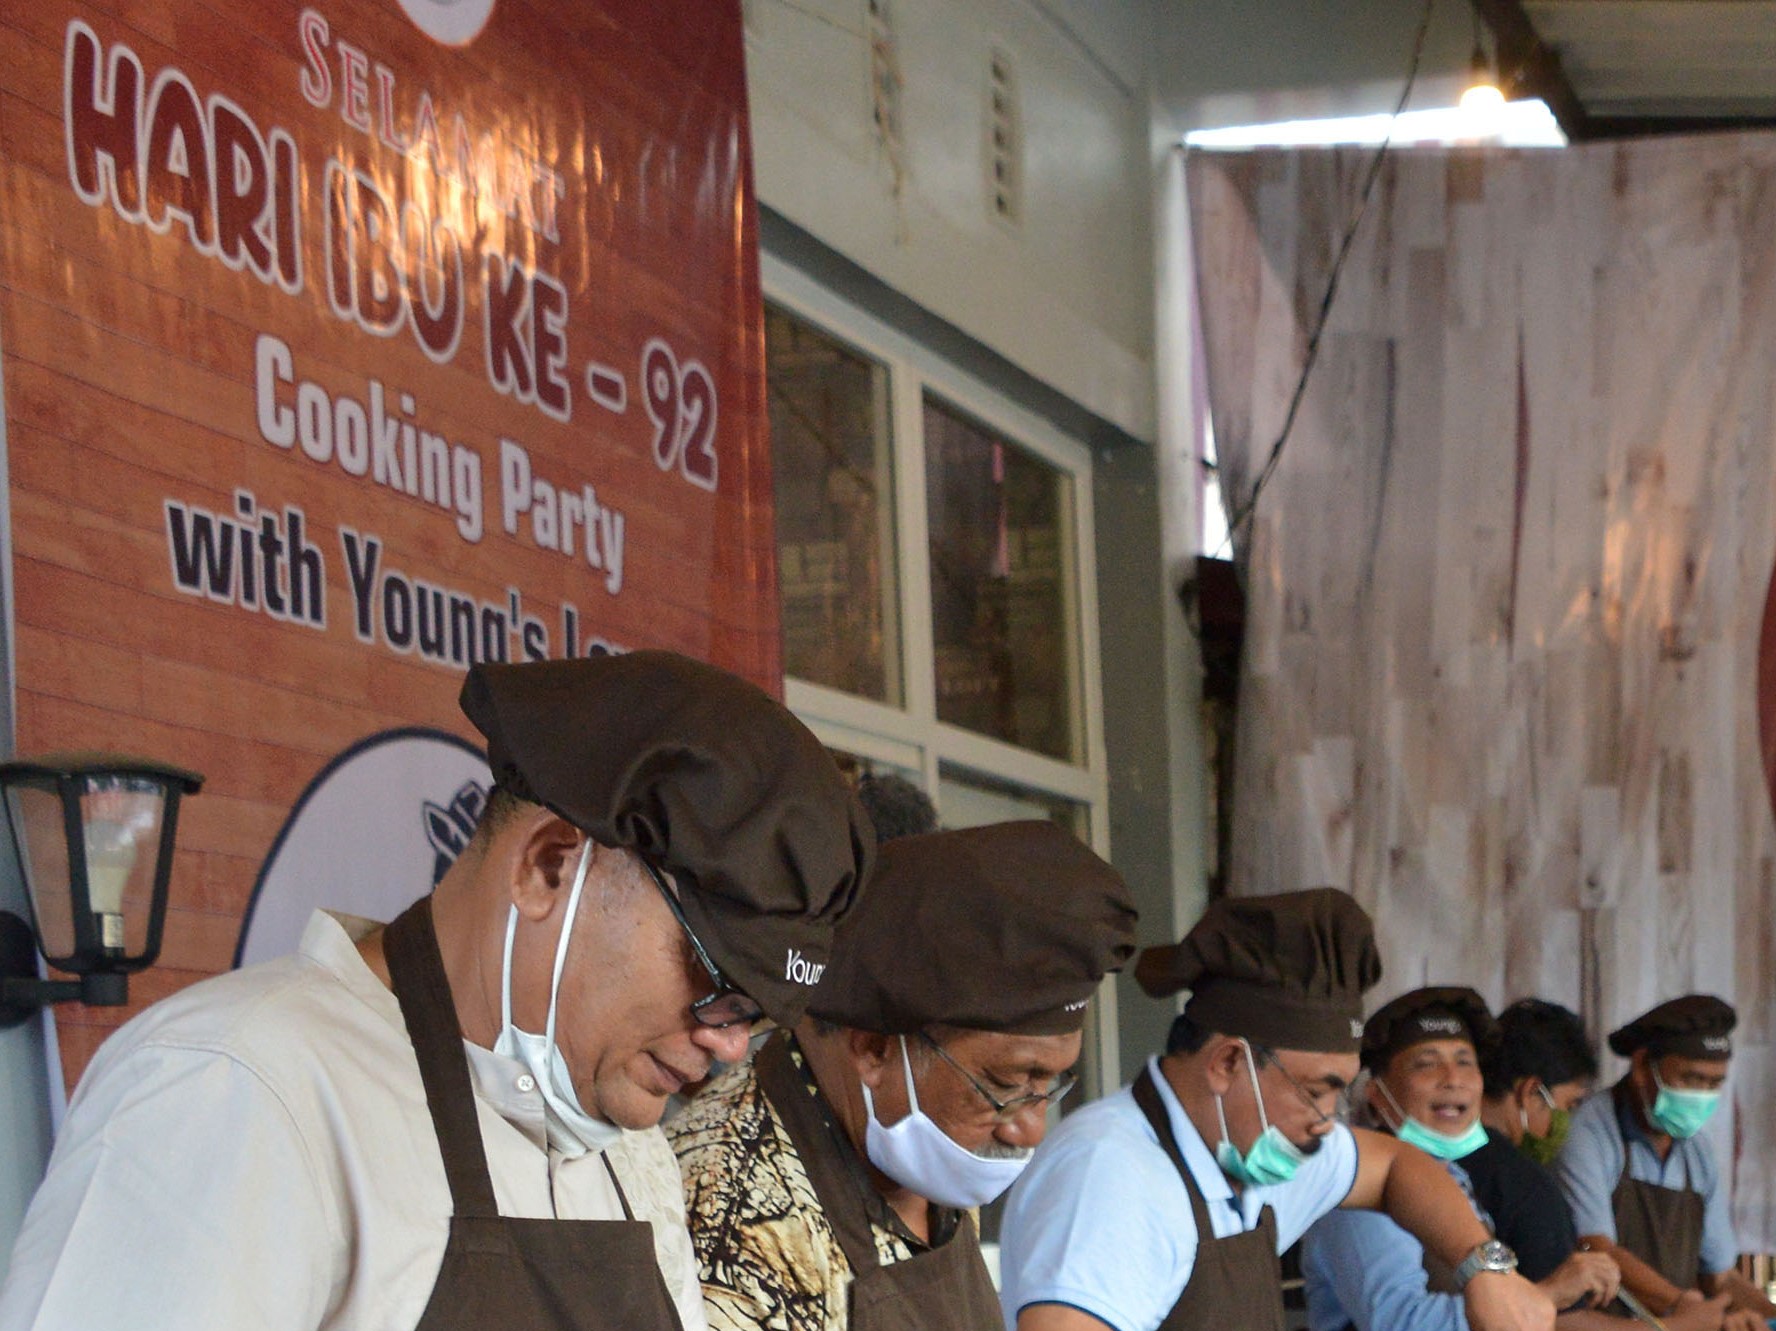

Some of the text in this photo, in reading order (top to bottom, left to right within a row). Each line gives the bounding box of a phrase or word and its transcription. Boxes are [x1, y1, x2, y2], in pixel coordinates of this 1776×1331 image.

[65, 19, 304, 295] HARI
[325, 158, 463, 364] IBU
[483, 250, 571, 422] KE
[642, 337, 719, 491] 92
[164, 487, 328, 626] with
[254, 333, 626, 594] Cooking Party
